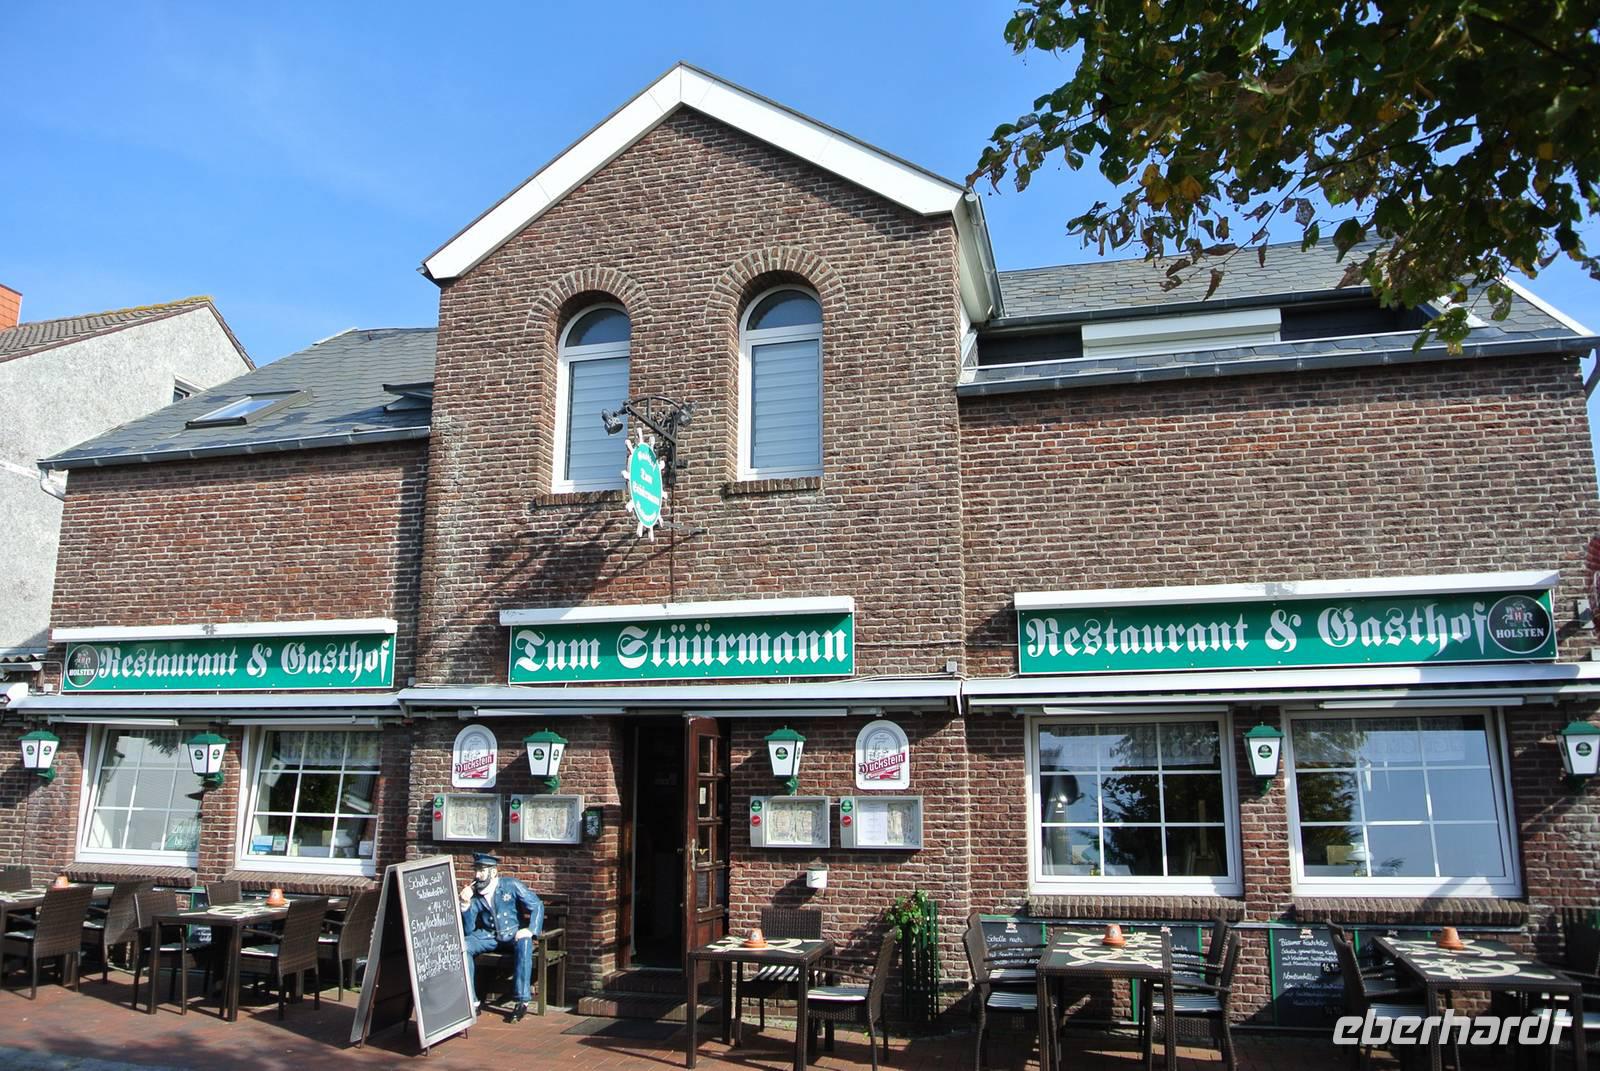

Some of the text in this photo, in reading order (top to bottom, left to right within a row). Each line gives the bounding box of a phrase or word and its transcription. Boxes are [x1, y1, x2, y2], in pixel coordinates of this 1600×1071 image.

[1025, 601, 1487, 657] Restaurant & Gasthof
[1496, 628, 1545, 639] HOLSTEN
[616, 623, 849, 669] Stüürmann
[69, 668, 96, 676] HOLSTEN
[99, 640, 391, 684] Restaurant & Gasthof
[455, 754, 493, 775] Duckstein
[859, 753, 904, 775] Duckstein
